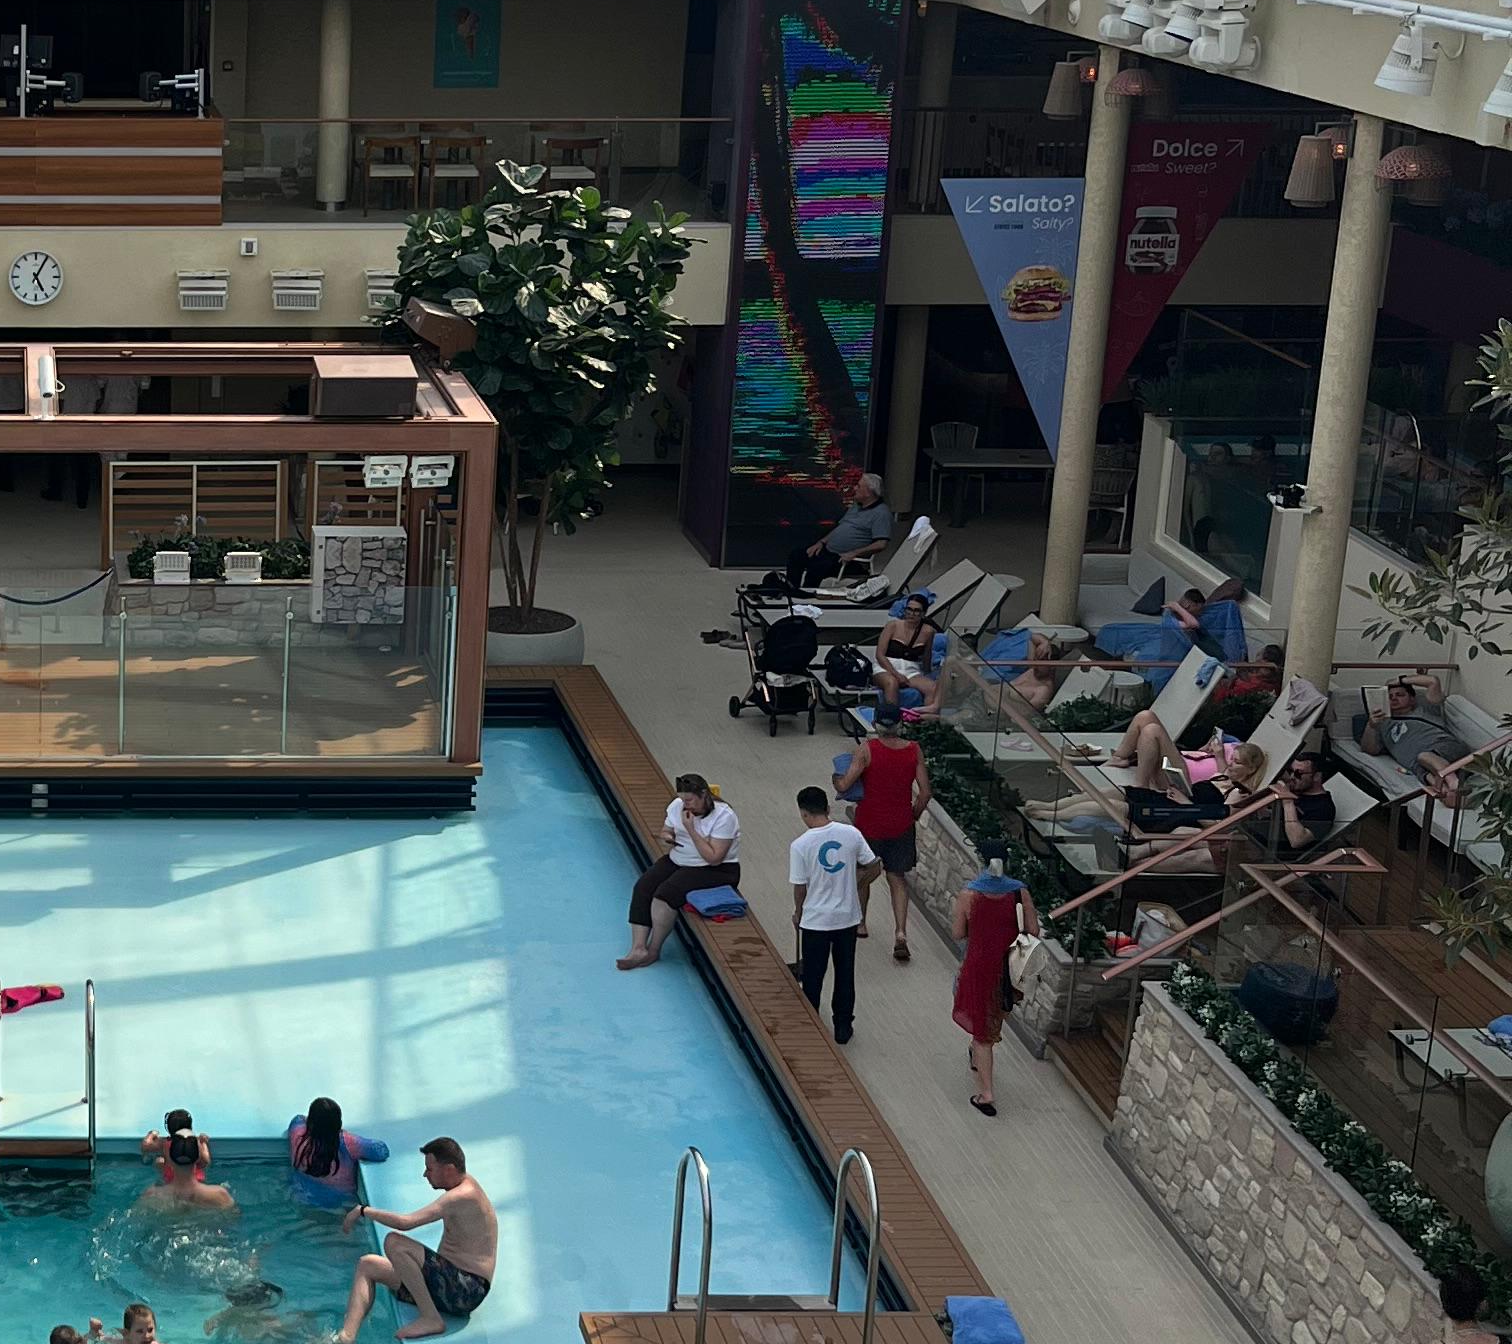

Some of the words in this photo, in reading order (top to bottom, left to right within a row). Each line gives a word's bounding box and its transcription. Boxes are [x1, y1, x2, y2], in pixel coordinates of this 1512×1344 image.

[1152, 139, 1218, 157] Dolce
[1164, 161, 1217, 174] Sweet?
[989, 194, 1075, 213] Salato?
[1032, 217, 1074, 232] Salty?
[1129, 236, 1176, 249] nutella
